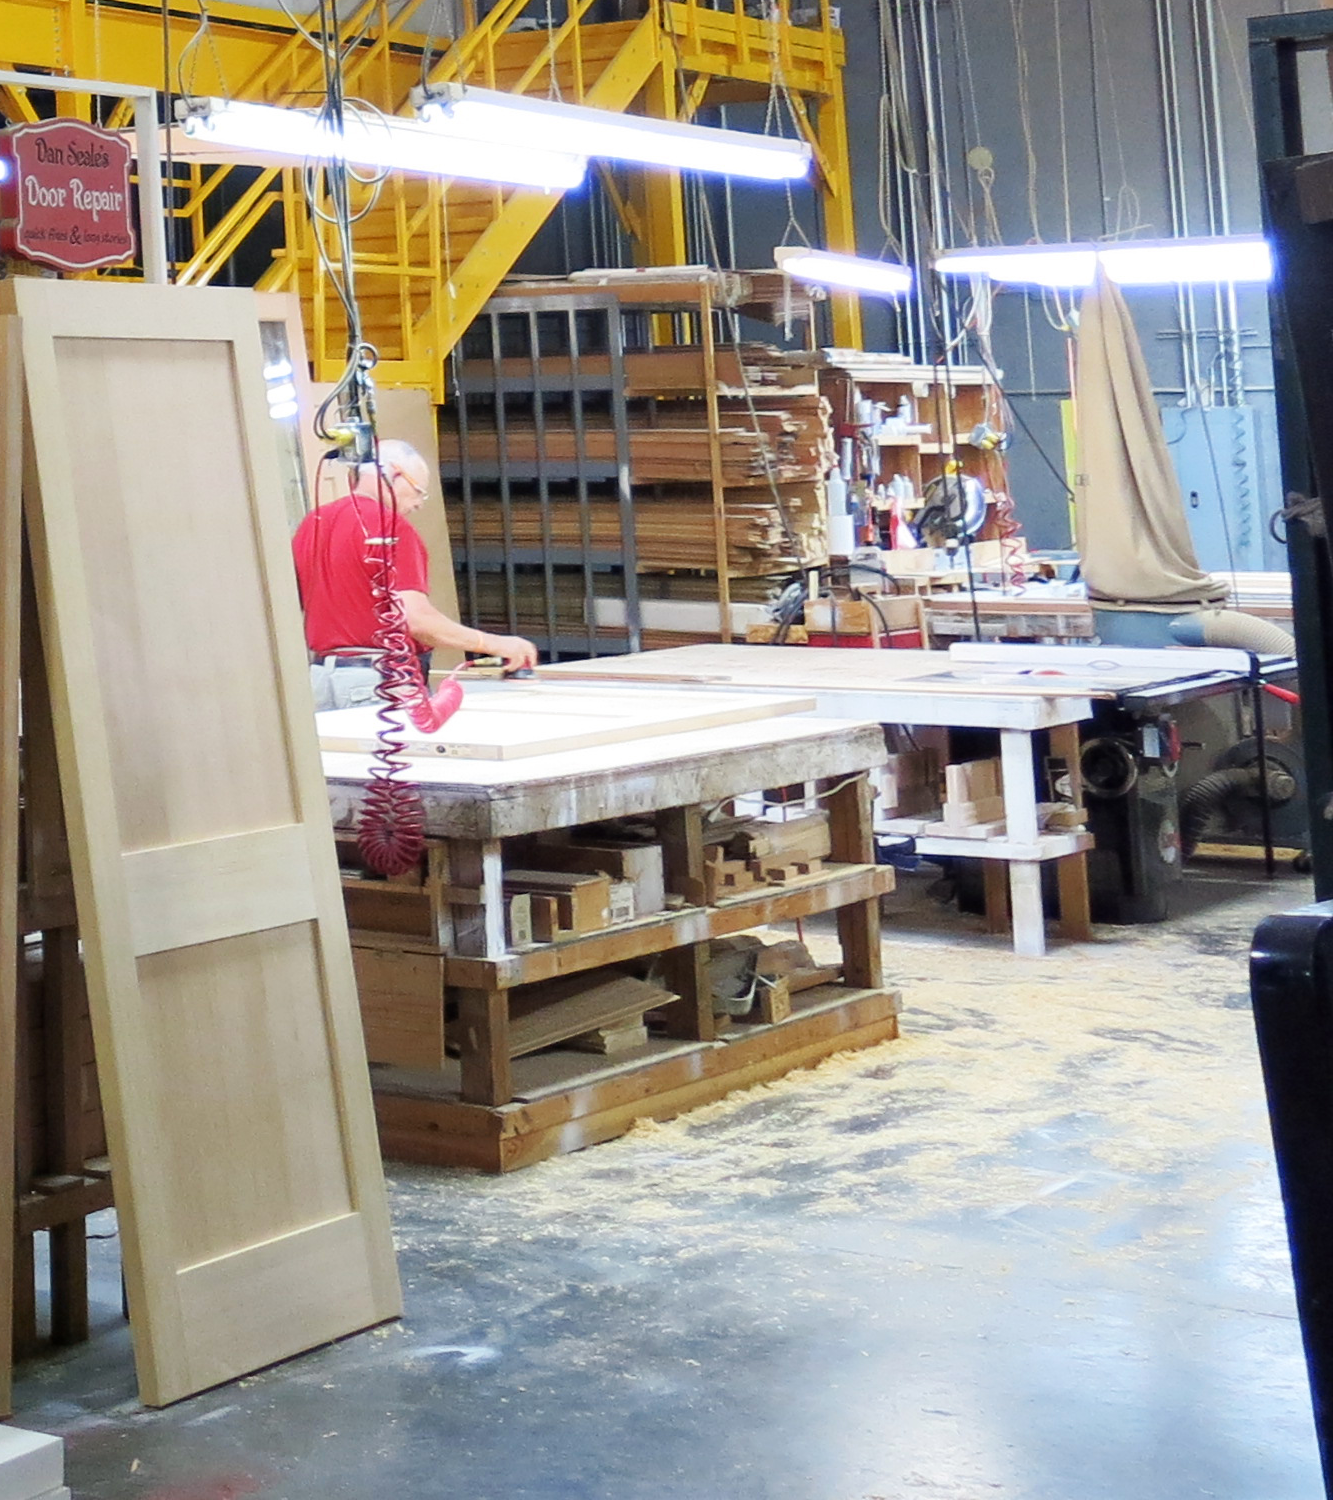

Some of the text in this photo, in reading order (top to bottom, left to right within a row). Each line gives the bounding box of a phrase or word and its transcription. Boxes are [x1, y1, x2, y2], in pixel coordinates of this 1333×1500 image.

[35, 137, 110, 168] Dan Seale's
[25, 175, 124, 222] Door Repair
[69, 226, 82, 244] &
